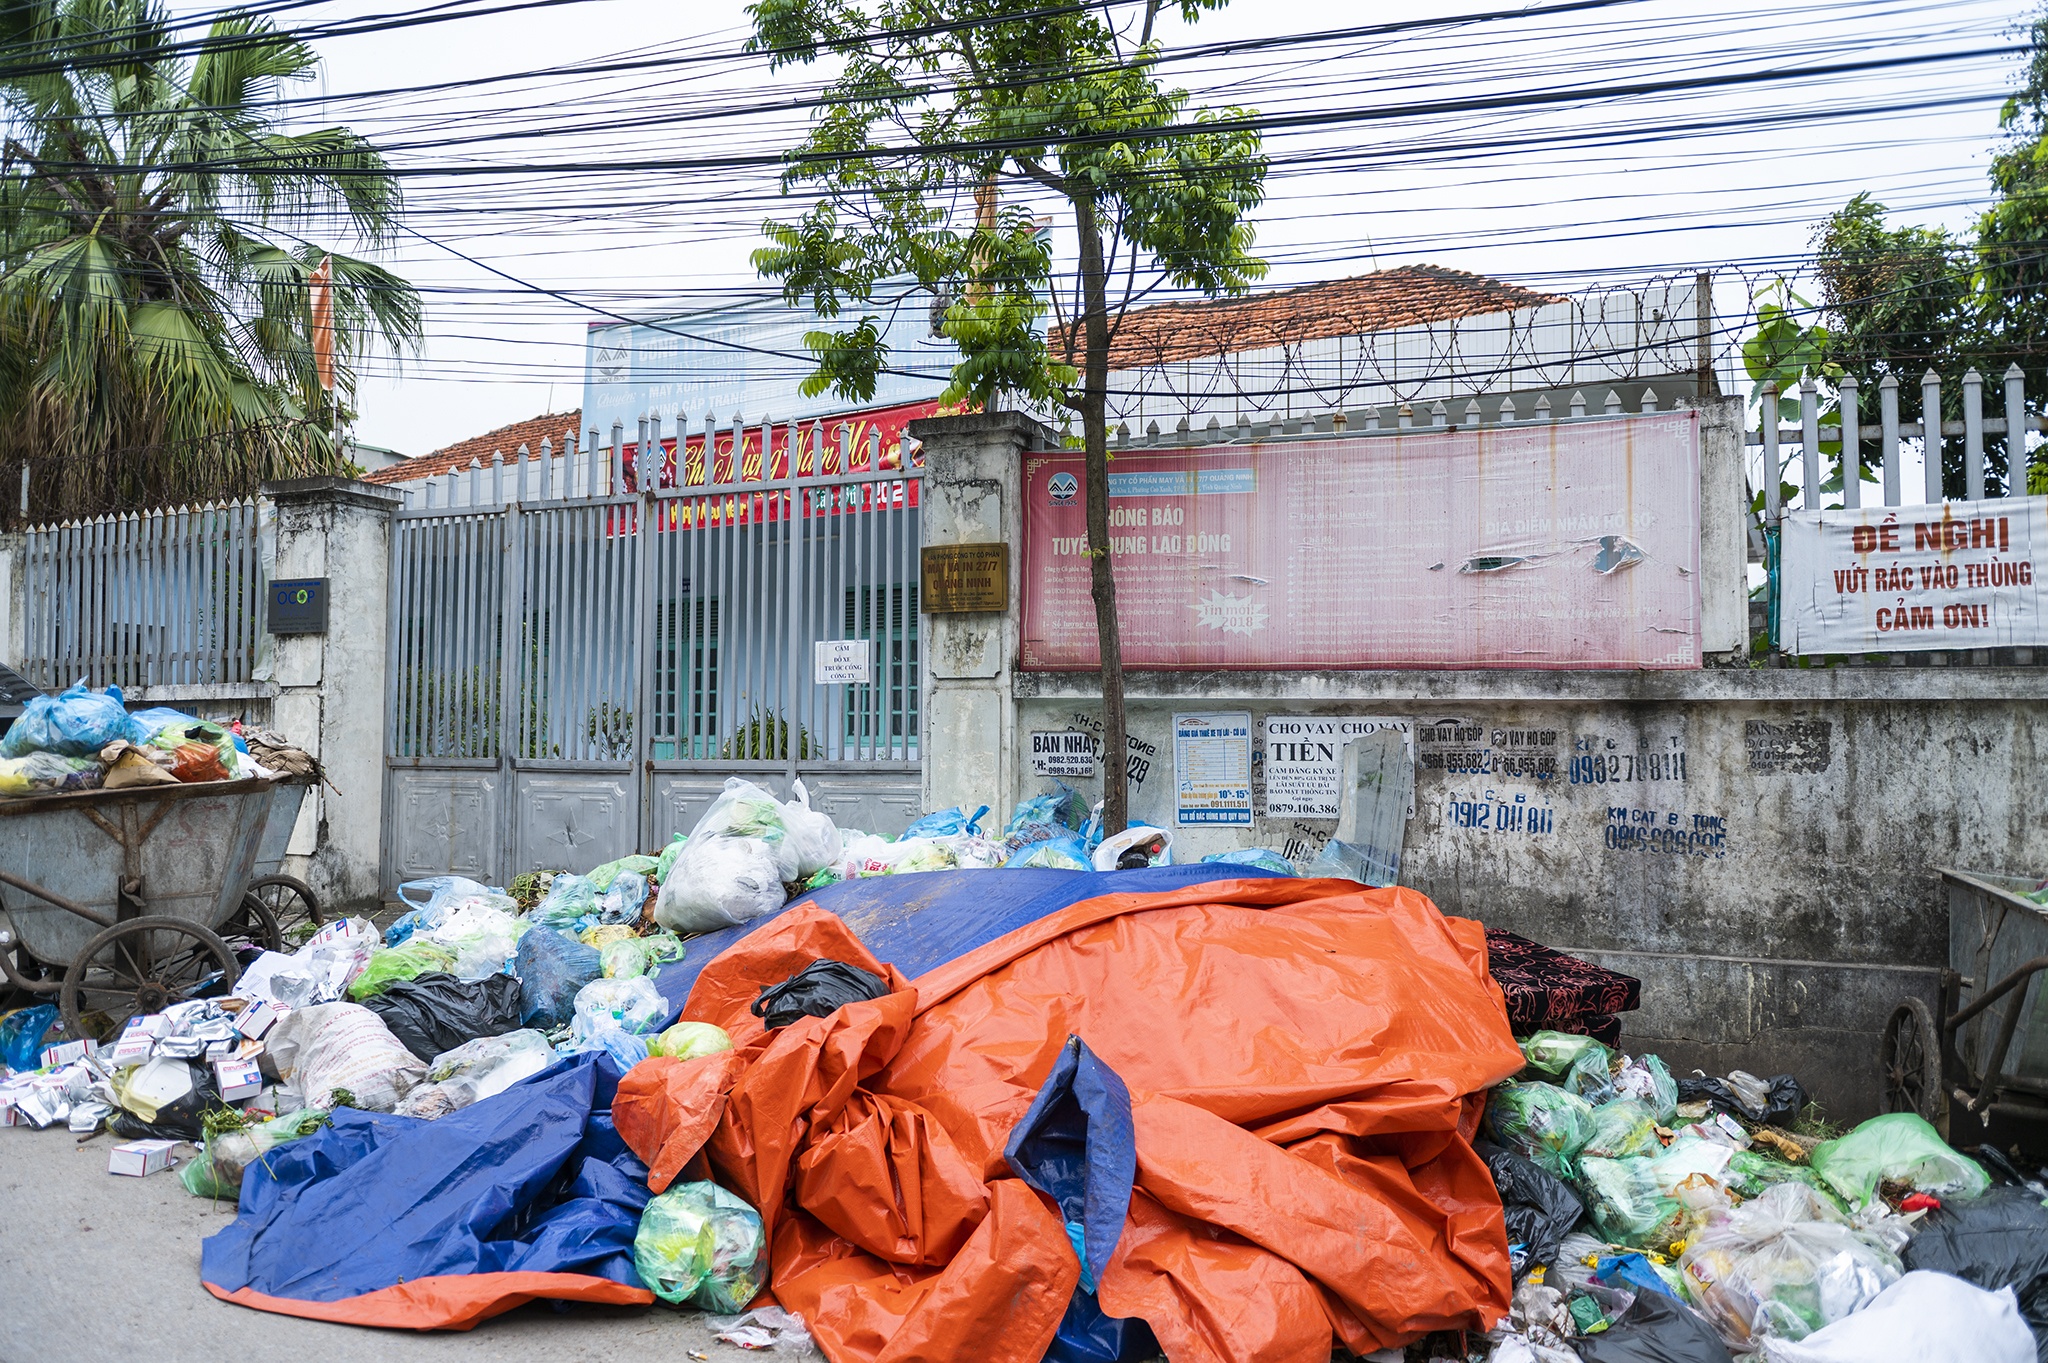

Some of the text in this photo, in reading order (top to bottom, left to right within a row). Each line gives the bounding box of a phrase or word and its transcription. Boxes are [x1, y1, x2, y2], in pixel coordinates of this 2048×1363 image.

[650, 385, 672, 399] MAY
[1108, 504, 1184, 527] HÔNG BÁO
[1852, 513, 2009, 554] ĐỀ NGHỊ
[1052, 530, 1089, 556] TUYỂ
[1152, 536, 1181, 555] LAO
[1185, 531, 1231, 557] ĐỘNG
[928, 563, 946, 574] MAY
[963, 561, 973, 571] IN
[976, 561, 998, 571] 27/7
[1833, 556, 2032, 593] VỨT RÁC VÀO THÙNG
[966, 577, 991, 588] NINH
[1203, 605, 1222, 616] Tin
[1876, 597, 1989, 632] CẢM ƠN!
[1222, 616, 1253, 628] 2018
[1269, 723, 1336, 734] CHO VAY
[1341, 723, 1375, 734] CHO
[1420, 728, 1435, 742] CHO
[1438, 728, 1452, 742] VAY
[1033, 732, 1060, 753] BÁN
[1491, 729, 1507, 745] CO
[1509, 730, 1525, 746] VAY
[1271, 737, 1334, 762] TIỀN
[1493, 757, 1556, 773] 066.955.682
[1269, 803, 1337, 814] 0879.106.386
[1449, 801, 1490, 829] 0912
[1527, 807, 1553, 834] 811
